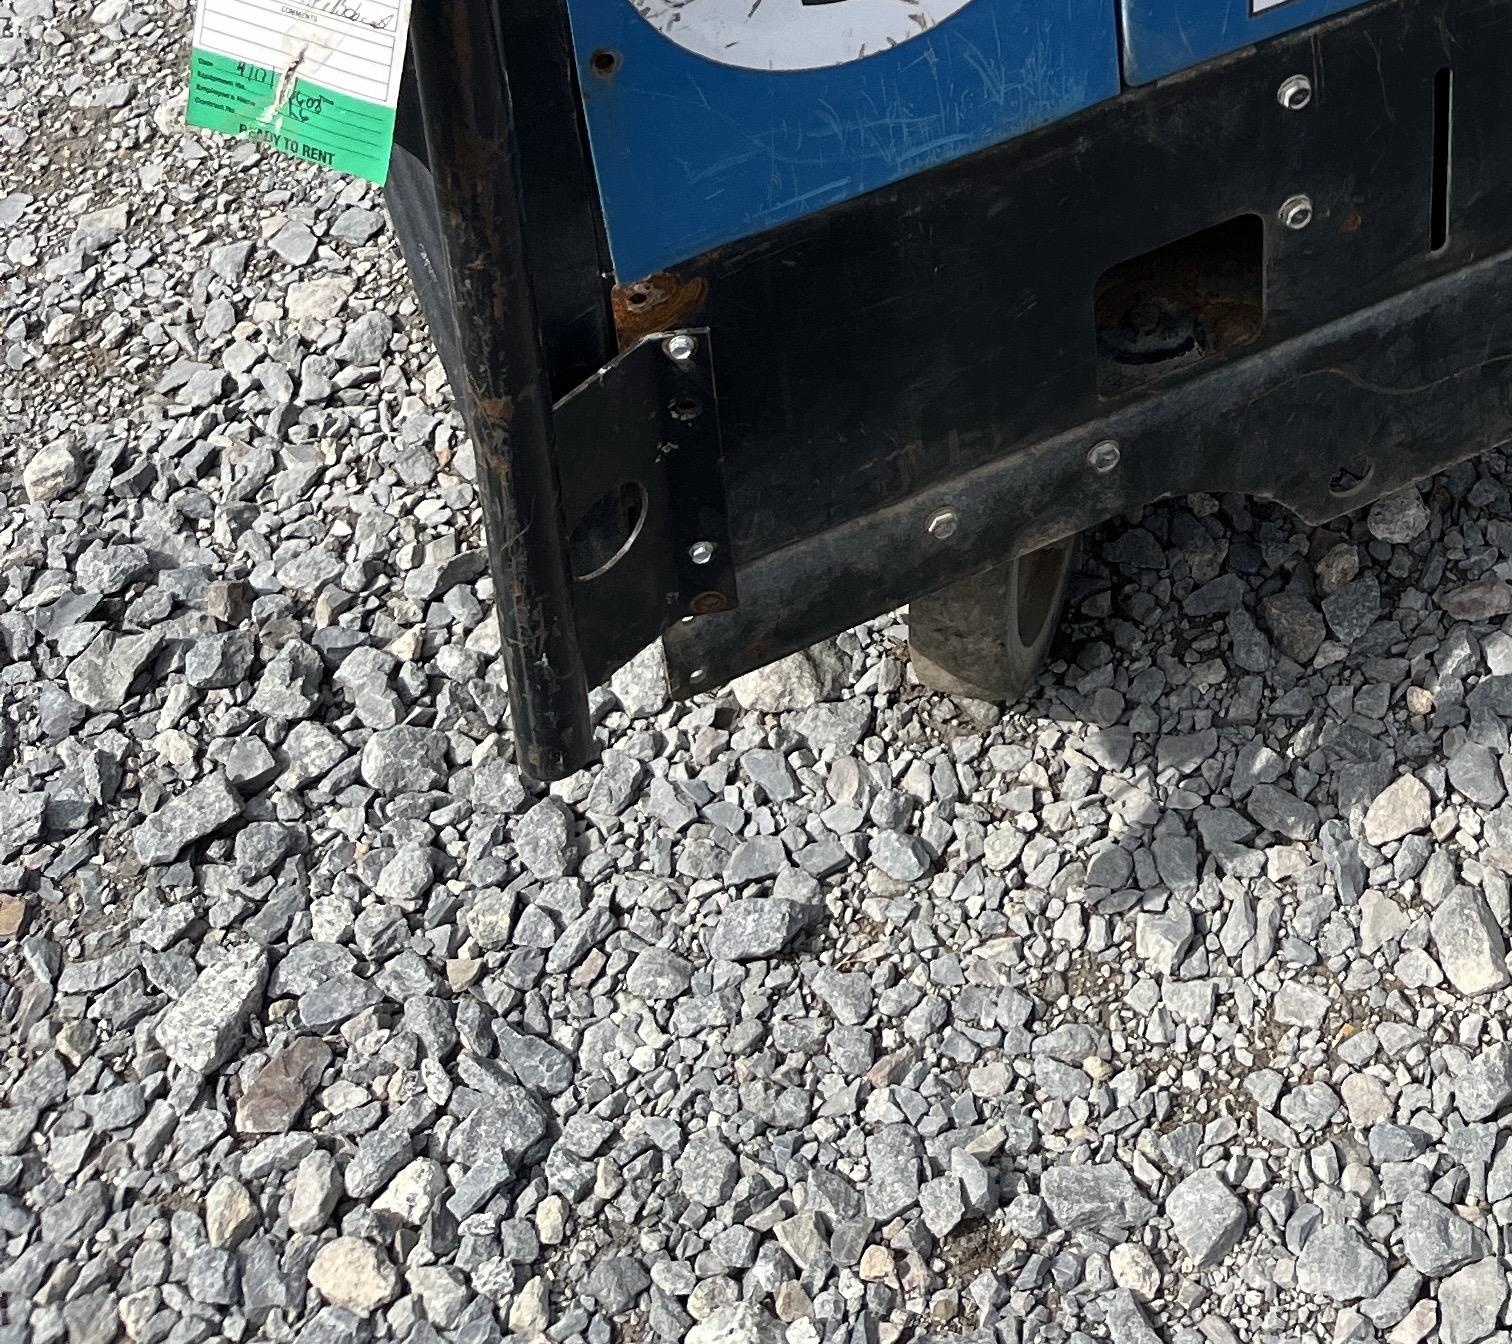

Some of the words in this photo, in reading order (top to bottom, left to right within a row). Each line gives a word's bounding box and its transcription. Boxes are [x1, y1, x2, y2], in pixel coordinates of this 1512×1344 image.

[281, 5, 318, 23] COMMENTS
[284, 135, 299, 154] TO
[302, 143, 336, 166] RENT
